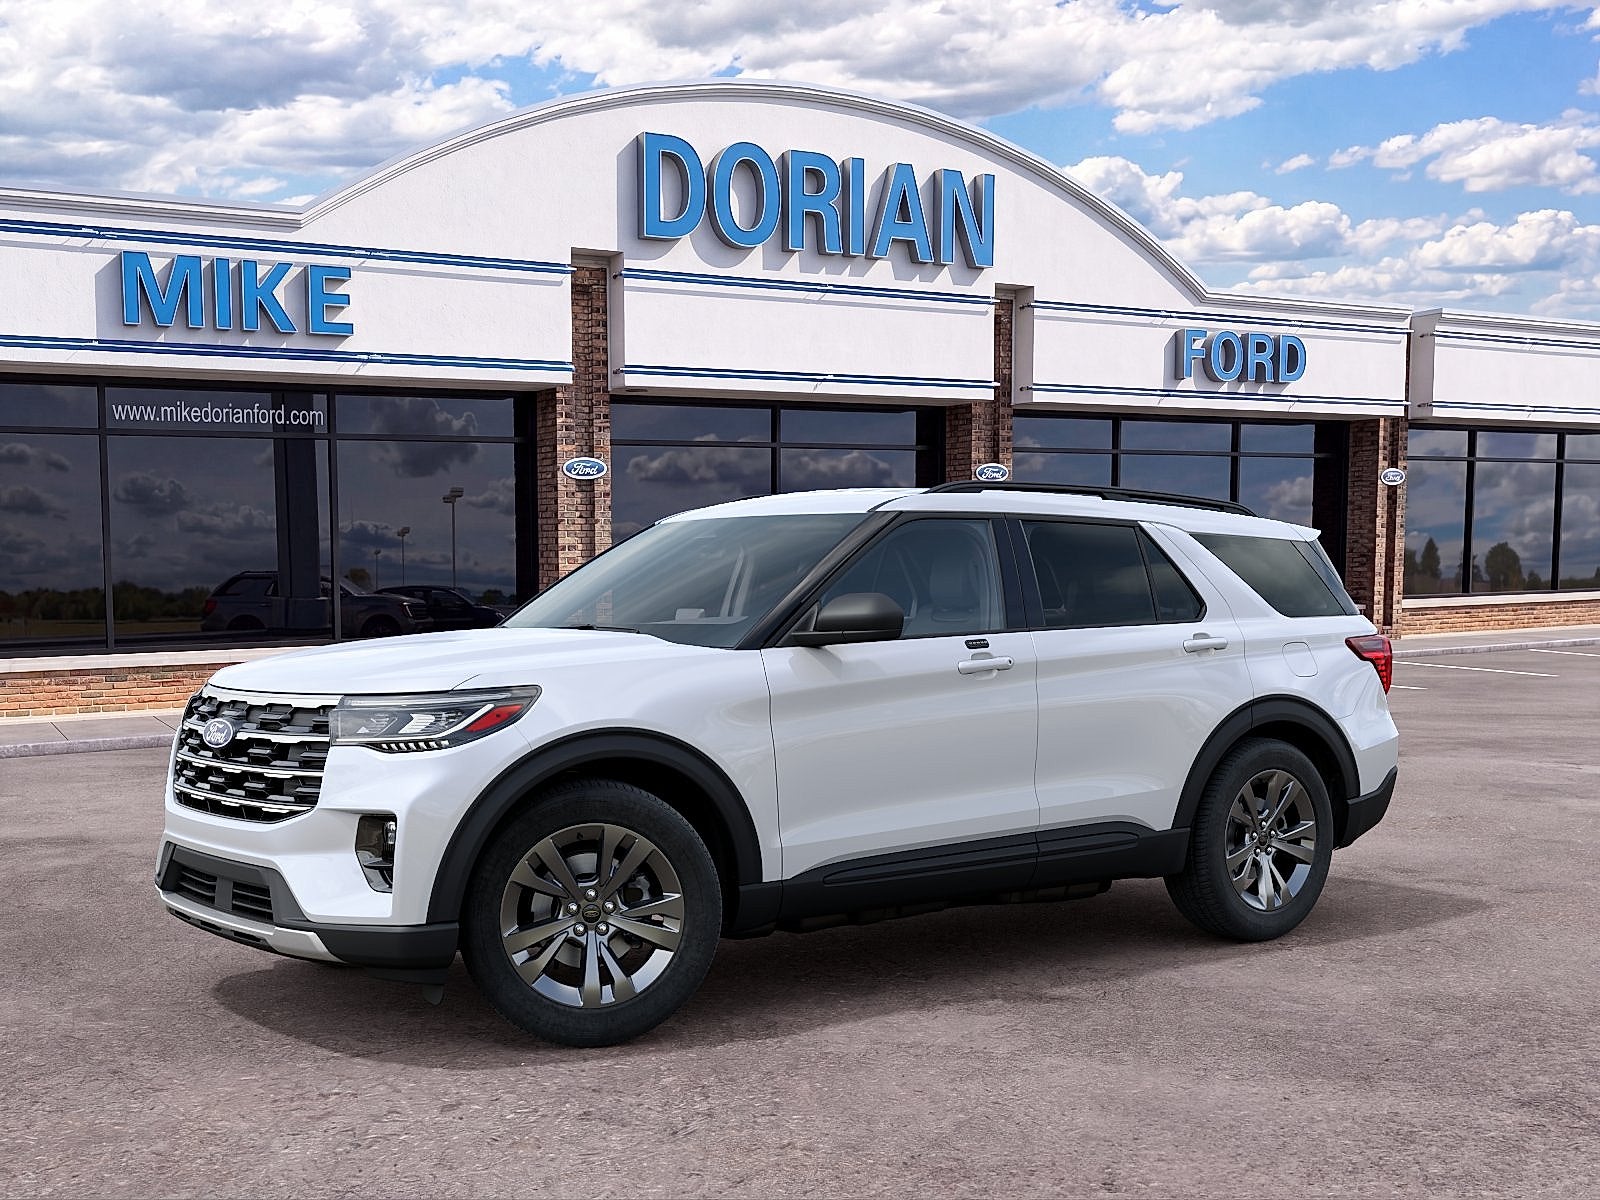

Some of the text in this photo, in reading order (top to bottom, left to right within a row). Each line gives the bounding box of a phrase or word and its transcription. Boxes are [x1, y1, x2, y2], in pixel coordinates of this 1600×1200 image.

[638, 131, 996, 268] DORIAN
[120, 250, 355, 337] MIKE
[1176, 328, 1307, 384] FORD
[112, 401, 325, 426] www.mikedorianford.com
[571, 462, 599, 475] Ford
[206, 722, 228, 743] Ford
